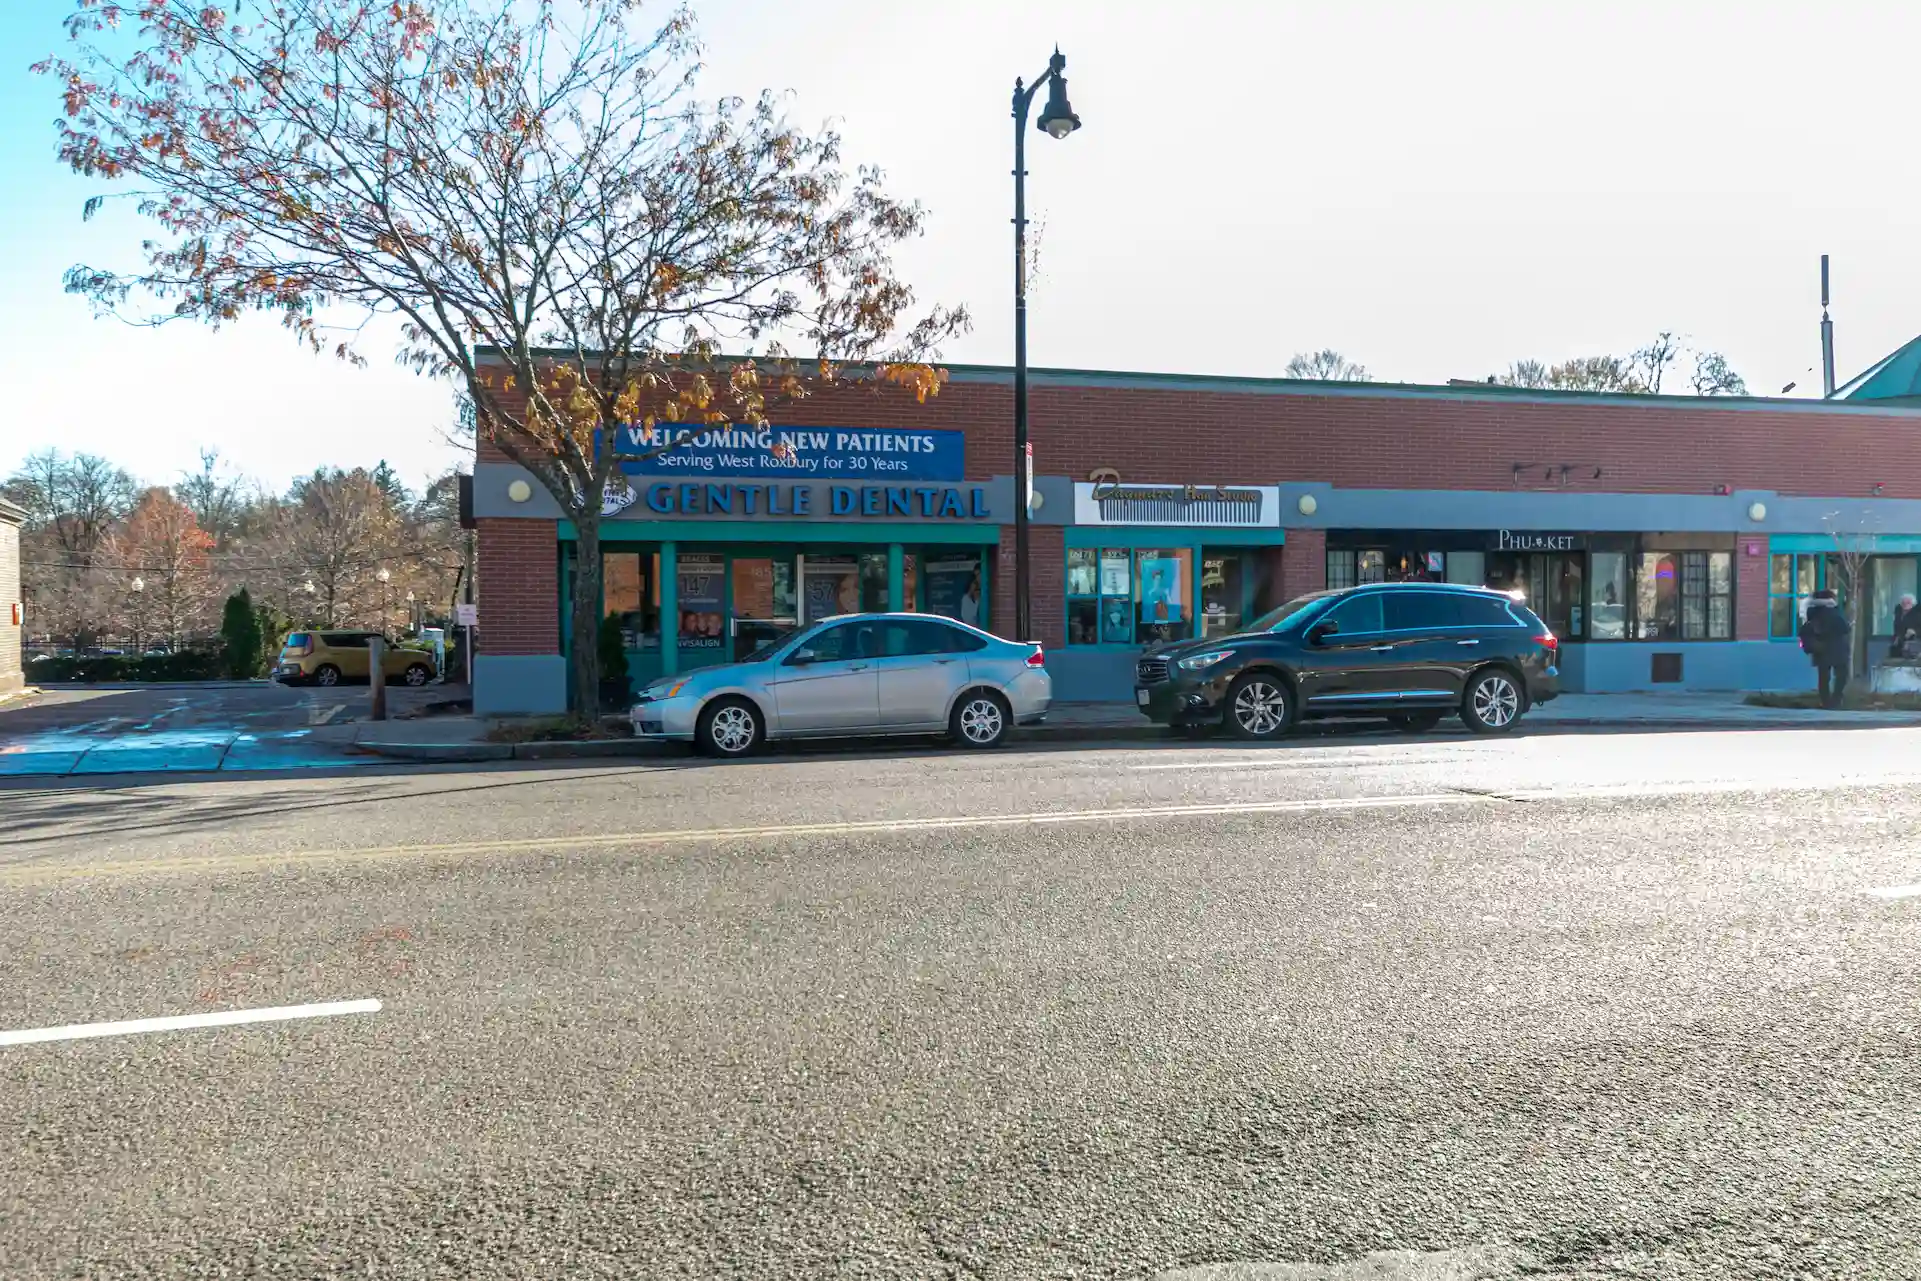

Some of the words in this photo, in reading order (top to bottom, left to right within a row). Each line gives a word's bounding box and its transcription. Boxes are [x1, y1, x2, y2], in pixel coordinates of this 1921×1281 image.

[781, 431, 829, 450] NEW
[836, 433, 935, 453] PATIENTS
[657, 453, 714, 471] Serving
[717, 454, 755, 468] West
[760, 455, 818, 472] Roxbury
[823, 456, 844, 470] for
[849, 457, 867, 470] 30
[871, 457, 908, 471] Years
[646, 483, 811, 515] GENTLE
[829, 486, 992, 517] DENTAL
[678, 639, 720, 648] NVISALIGN
